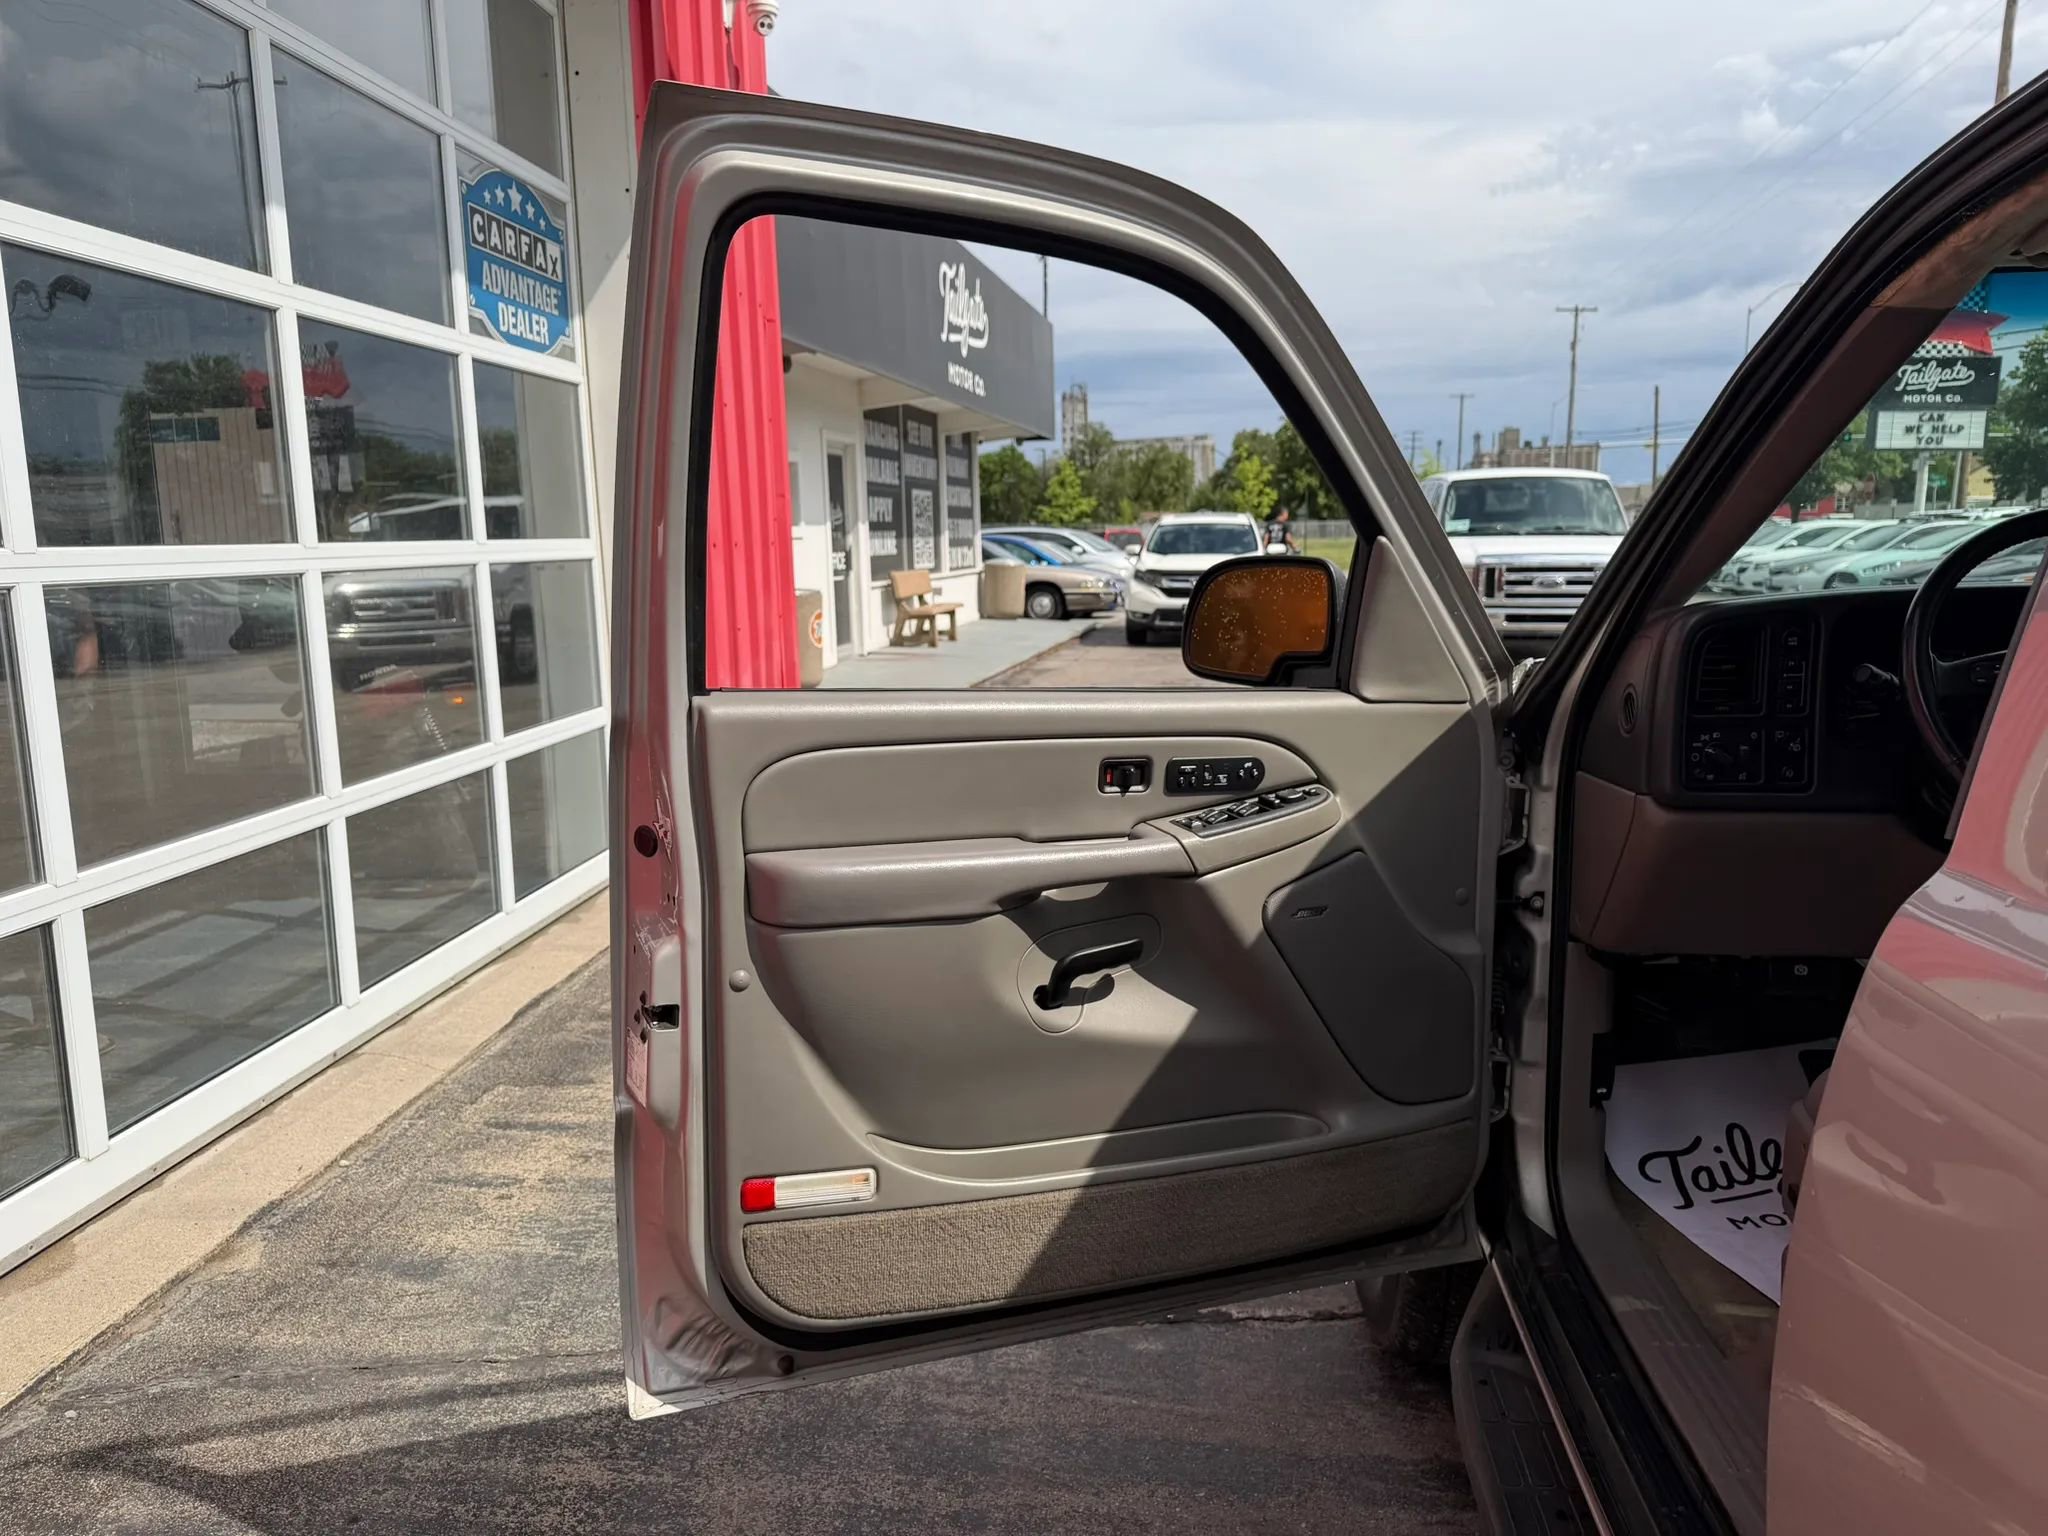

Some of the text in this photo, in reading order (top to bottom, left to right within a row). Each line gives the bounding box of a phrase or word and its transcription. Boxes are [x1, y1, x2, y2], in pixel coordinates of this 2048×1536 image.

[472, 212, 559, 279] CARFAX
[482, 260, 559, 316] ADVANTAGE
[498, 301, 549, 345] DEALER
[939, 261, 989, 358] Tailgate
[948, 361, 973, 393] MOTOR
[1895, 360, 1975, 392] Tailgate
[1904, 393, 1941, 403] MOTOR
[1904, 425, 1965, 434] WE HELP
[1918, 412, 1945, 422] CAN
[1916, 436, 1944, 445] YOU
[359, 664, 398, 681] HONDA
